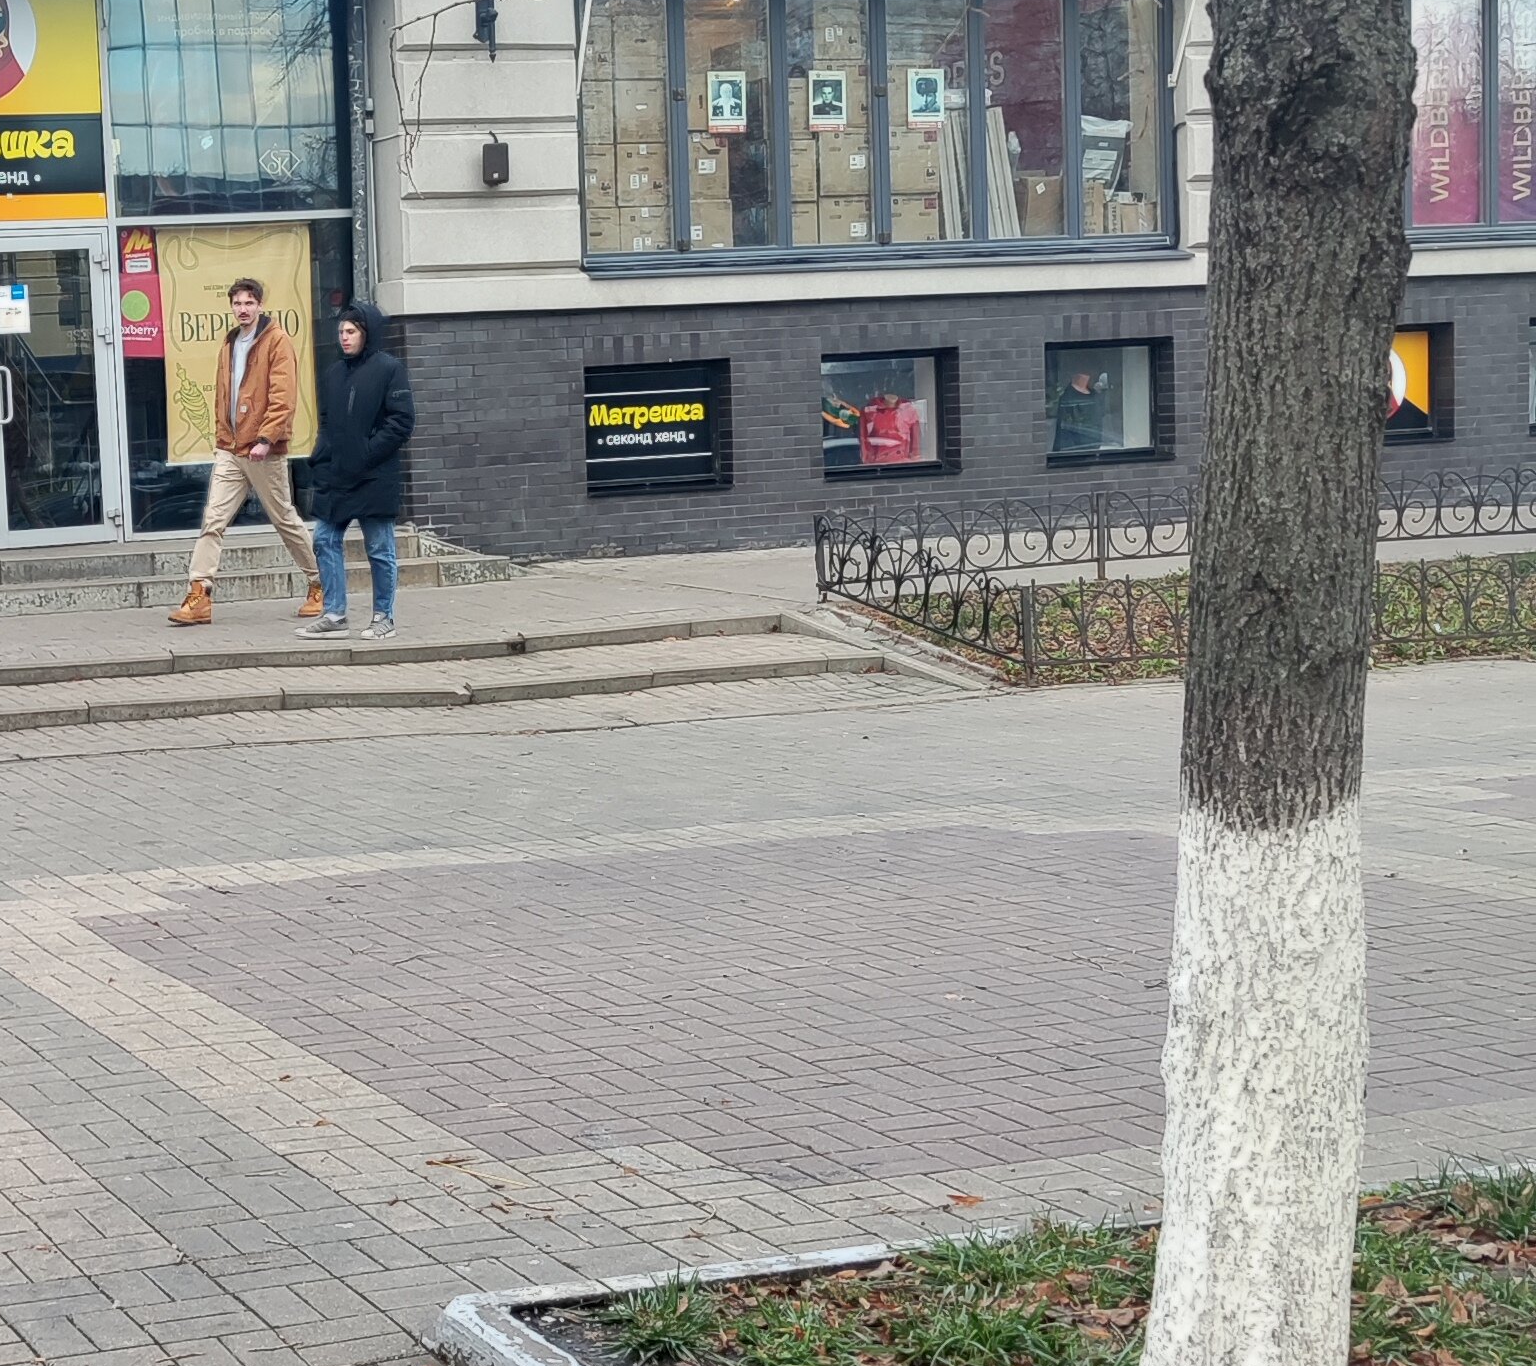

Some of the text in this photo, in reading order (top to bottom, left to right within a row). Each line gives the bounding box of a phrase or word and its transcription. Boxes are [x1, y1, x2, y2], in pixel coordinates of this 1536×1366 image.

[121, 325, 158, 337] oxberry
[179, 308, 299, 342] ВЕРЕО
[589, 403, 705, 429] Матрешка
[606, 430, 687, 446] секонд хенд
